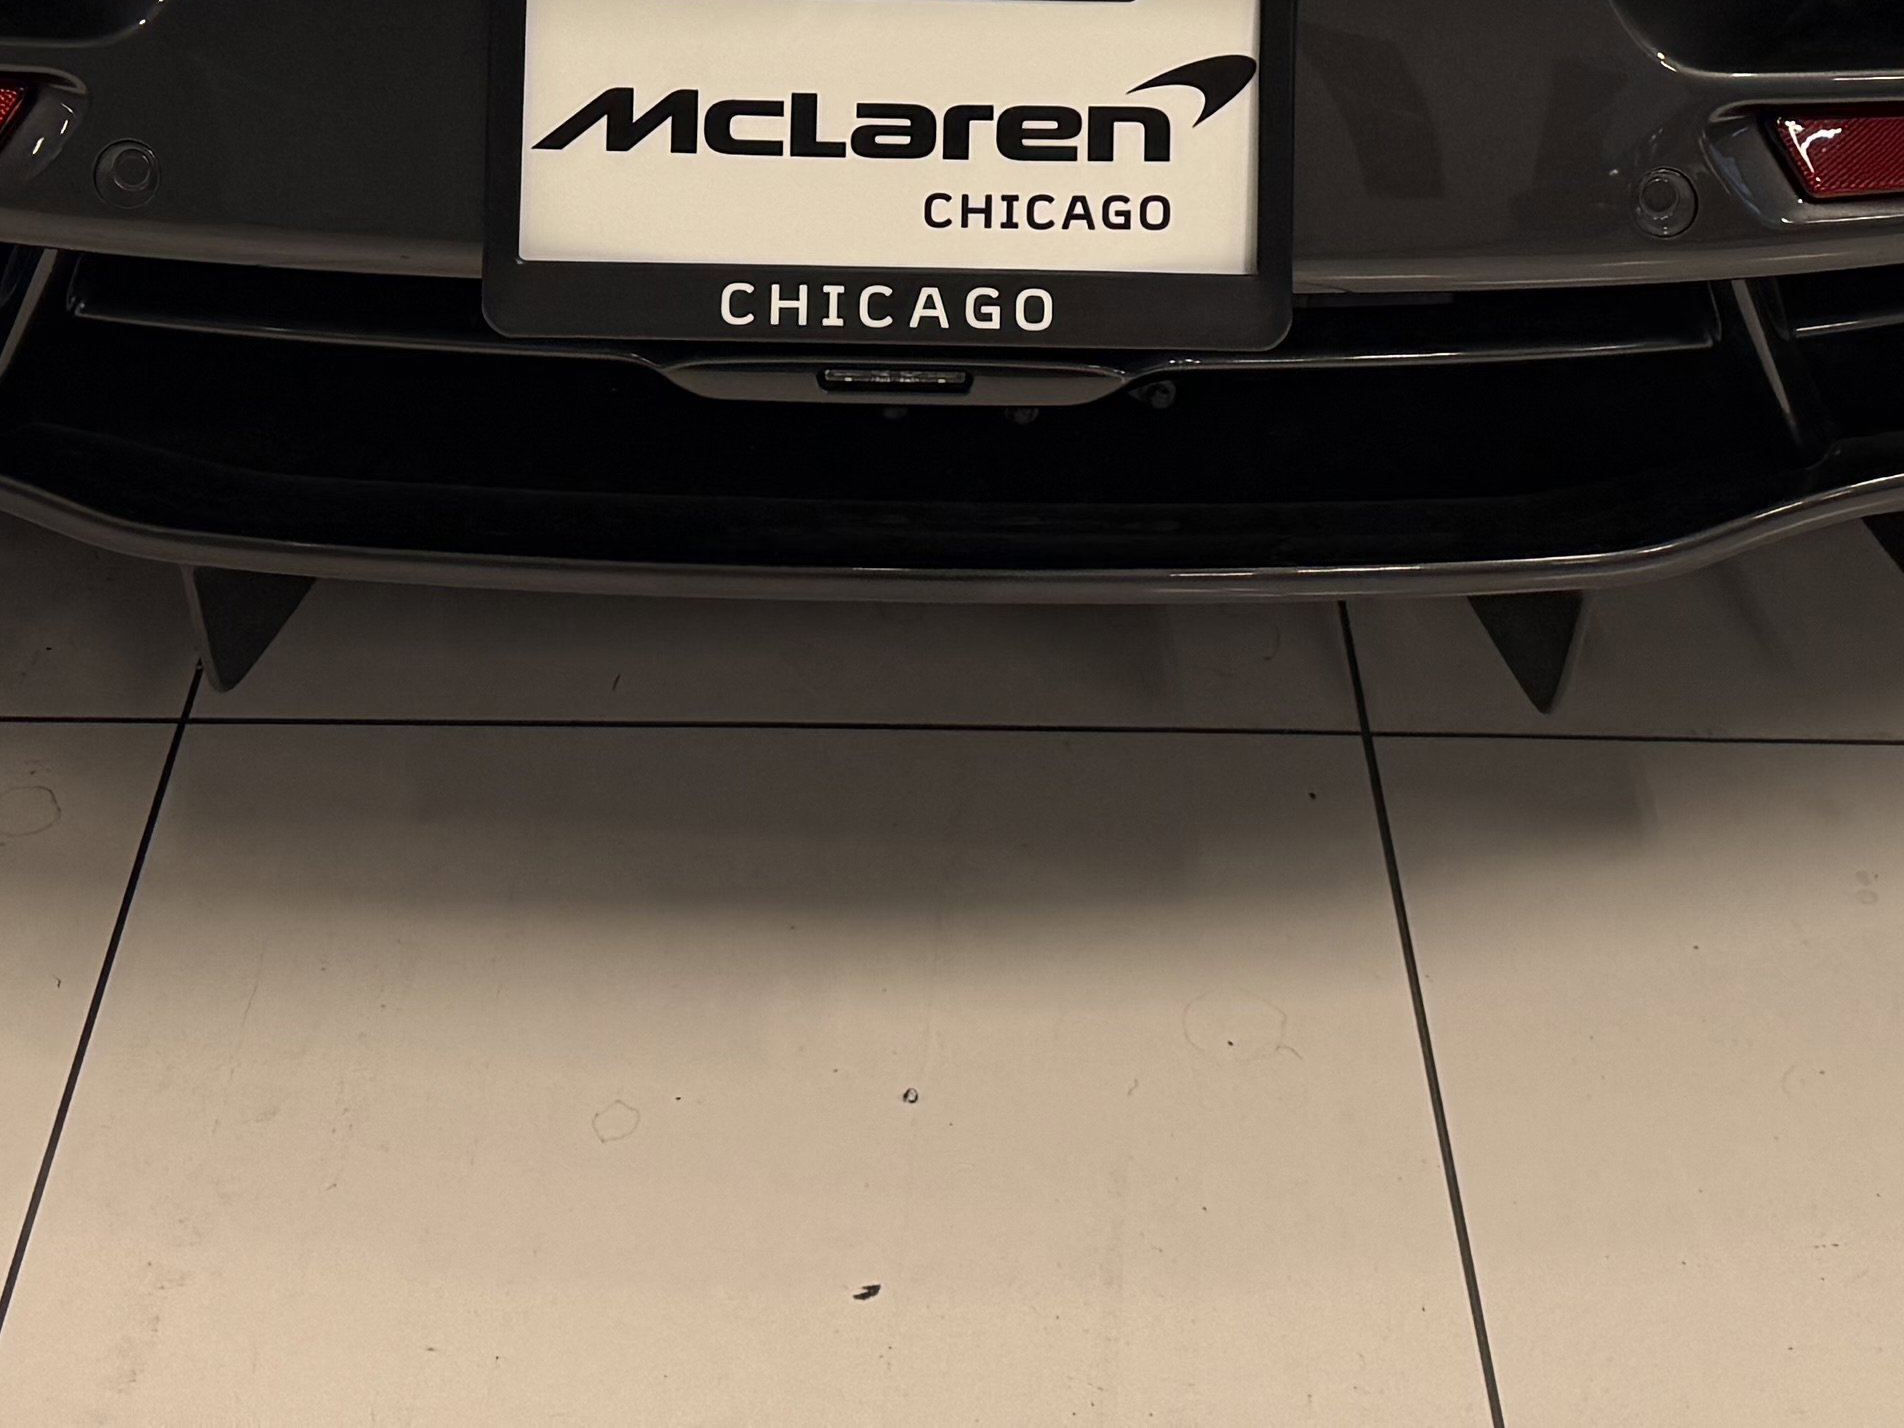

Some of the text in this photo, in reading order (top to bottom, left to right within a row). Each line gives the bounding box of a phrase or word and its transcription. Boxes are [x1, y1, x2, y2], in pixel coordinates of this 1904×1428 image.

[531, 87, 1171, 162] McLaren
[923, 192, 1172, 232] CHICAGO
[720, 281, 1054, 332] CHICAGO
